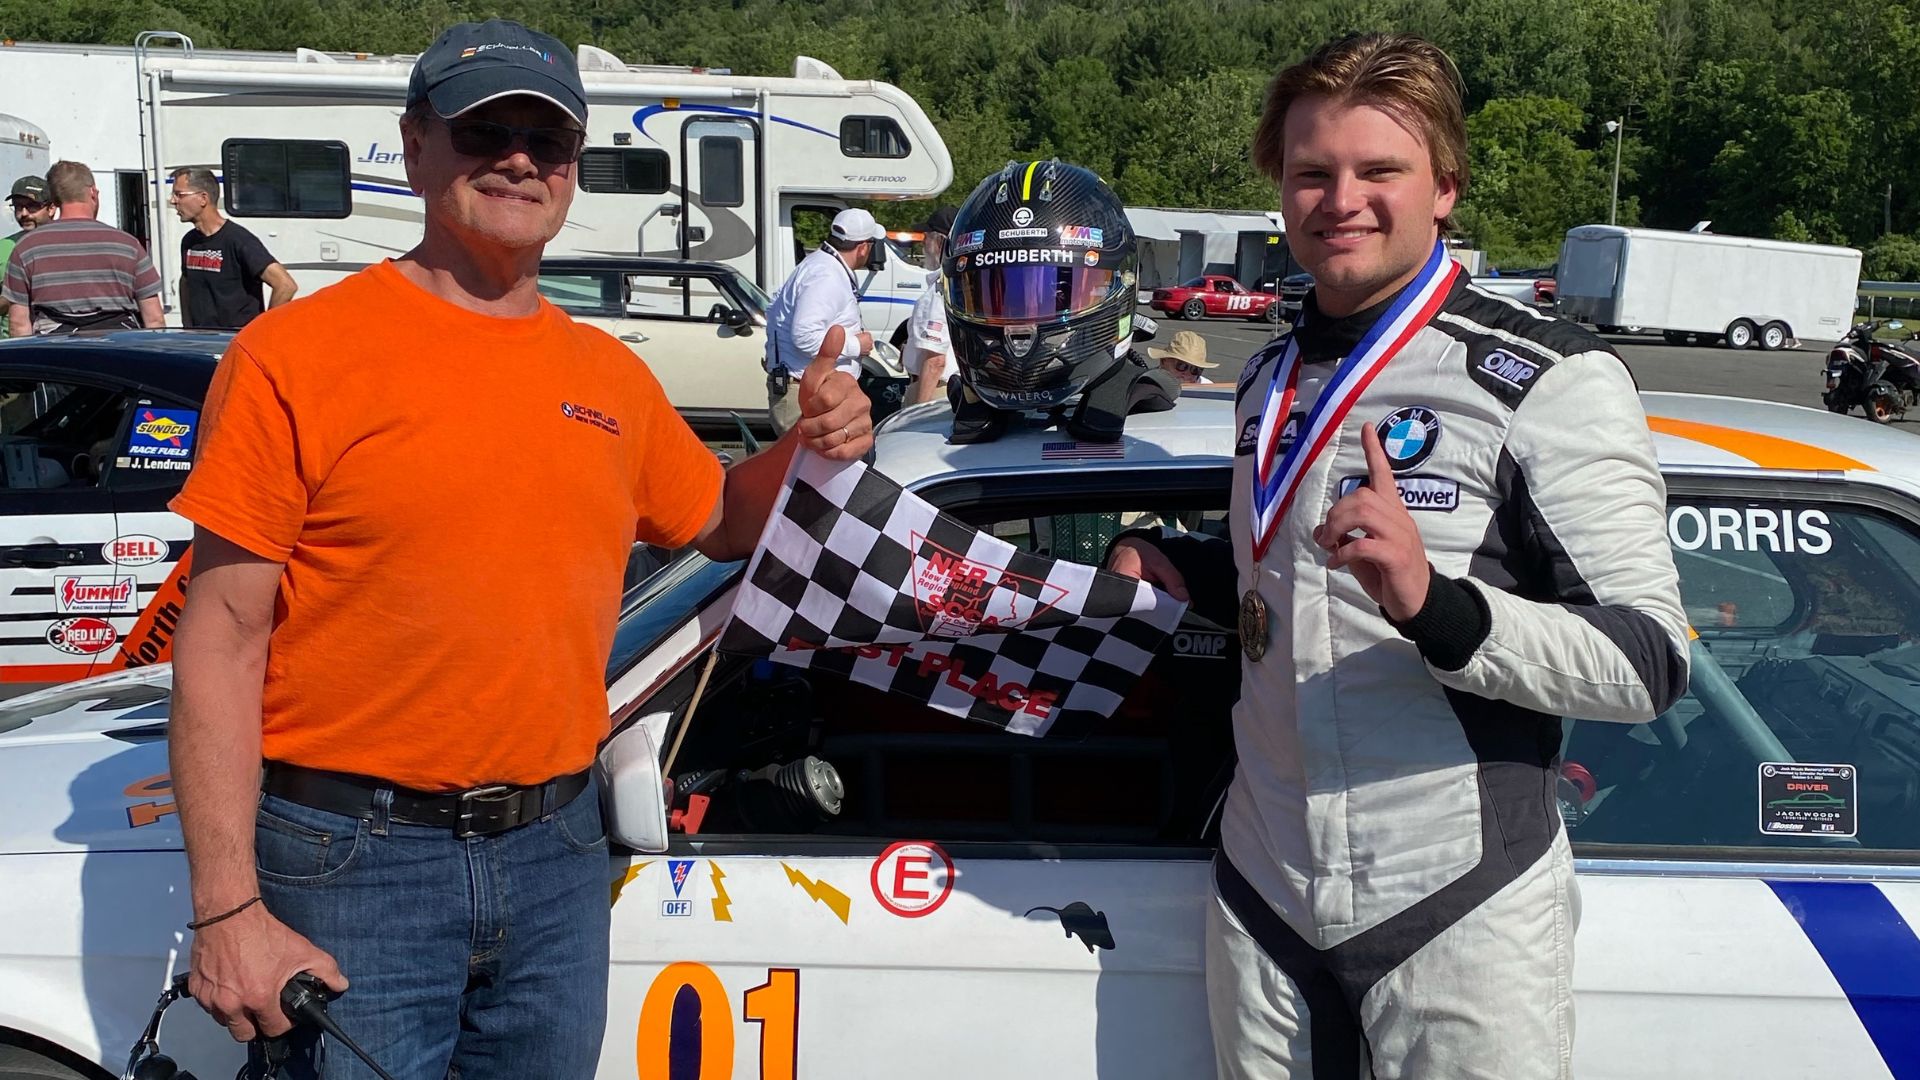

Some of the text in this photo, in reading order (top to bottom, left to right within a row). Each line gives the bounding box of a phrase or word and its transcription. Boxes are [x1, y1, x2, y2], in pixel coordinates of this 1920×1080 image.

[858, 175, 907, 183] FLEETWOOD
[1063, 226, 1103, 240] HMS
[975, 250, 1073, 267] SCHUBERTH
[1227, 296, 1251, 310] 118
[1484, 352, 1534, 383] OMP
[999, 390, 1050, 401] WALERO
[1387, 409, 1438, 432] BMW
[138, 424, 188, 434] SUNOCO
[129, 446, 189, 456] RACE FUELS
[131, 457, 191, 470] J. Lendrum
[113, 541, 159, 557] BELL
[927, 551, 988, 588] NER
[917, 577, 949, 594] Region
[921, 569, 981, 596] New England
[926, 594, 1000, 625] SCCA
[68, 628, 88, 641] RED
[1173, 633, 1226, 655] OMP
[918, 651, 1060, 719] PLACE
[1787, 783, 1829, 791] DRIVER
[893, 856, 931, 899] E
[666, 902, 687, 914] OFF
[636, 960, 800, 1080] 01
